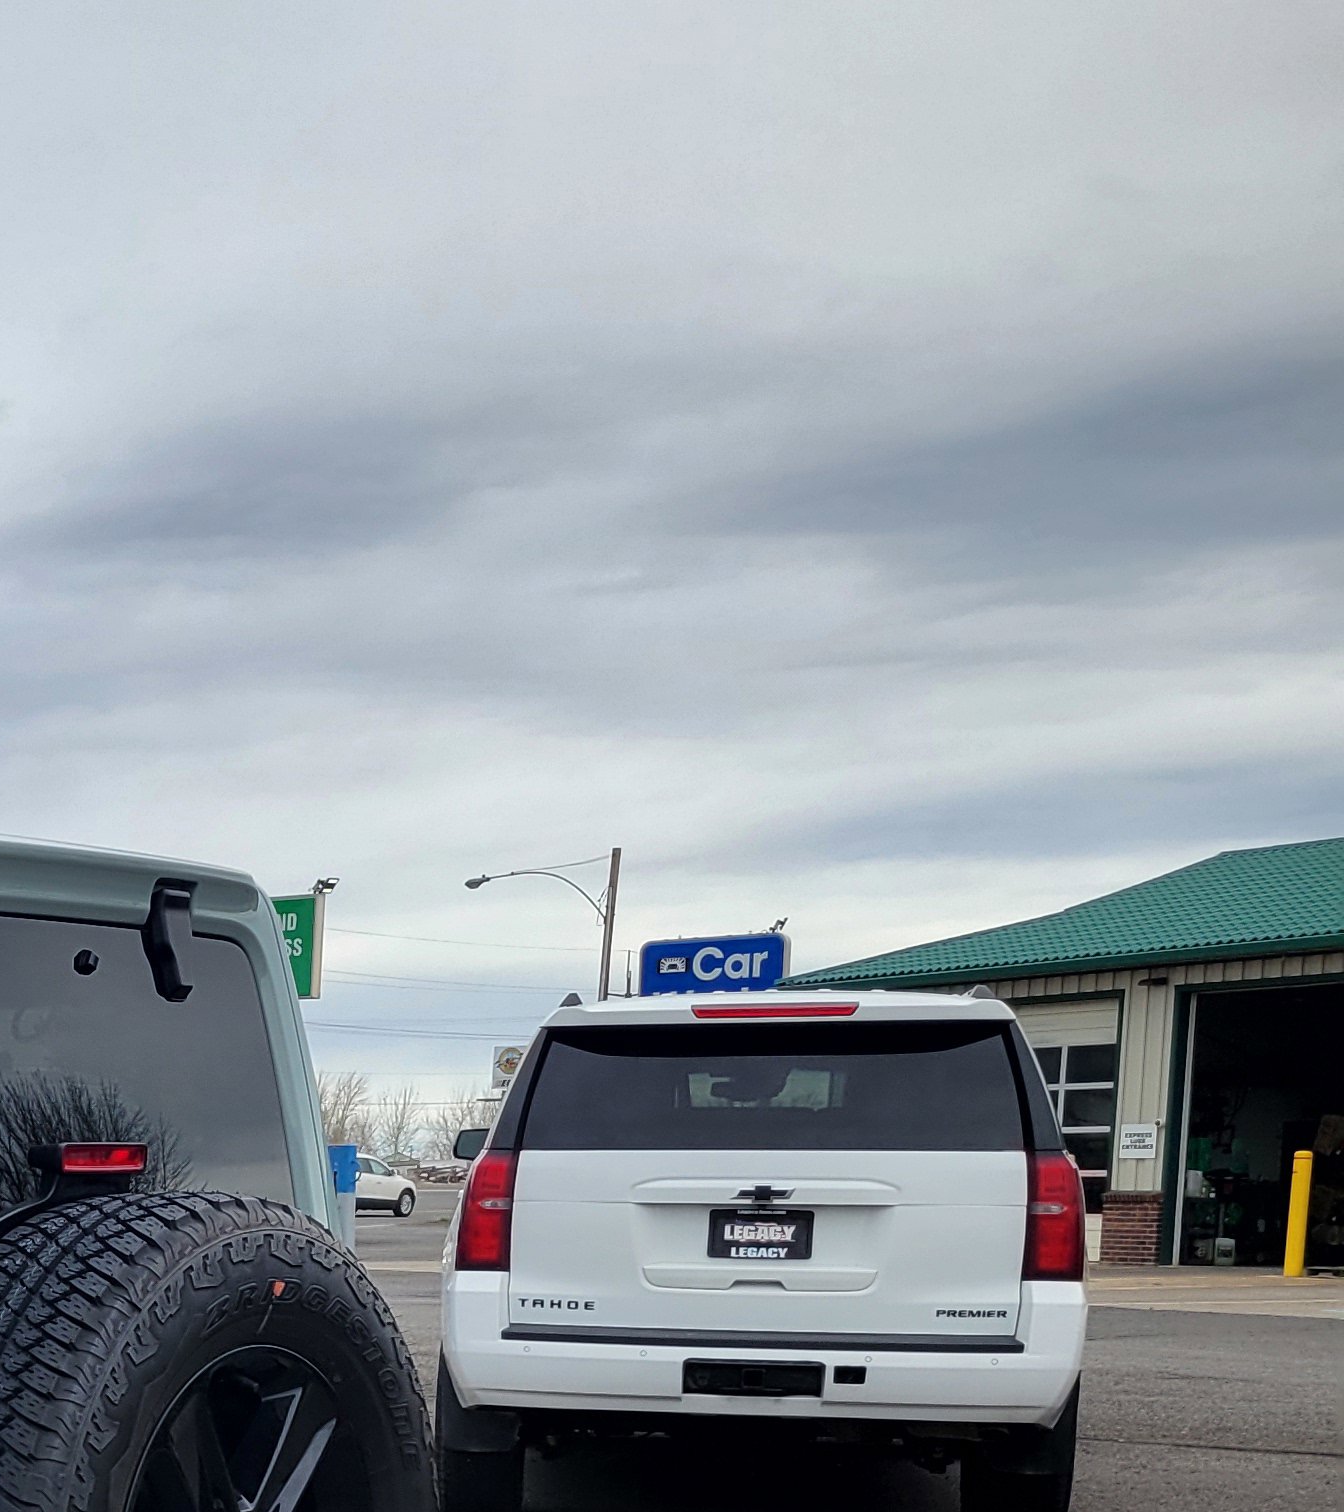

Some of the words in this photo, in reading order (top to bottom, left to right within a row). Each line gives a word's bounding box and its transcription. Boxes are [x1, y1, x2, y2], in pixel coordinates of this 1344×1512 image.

[692, 946, 769, 982] Car
[724, 1224, 797, 1241] LEGACY
[730, 1246, 789, 1258] LEGACY
[517, 1298, 596, 1311] TAHOE
[935, 1309, 1008, 1318] PREMIER
[200, 1276, 422, 1472] BRIDGESTONE
